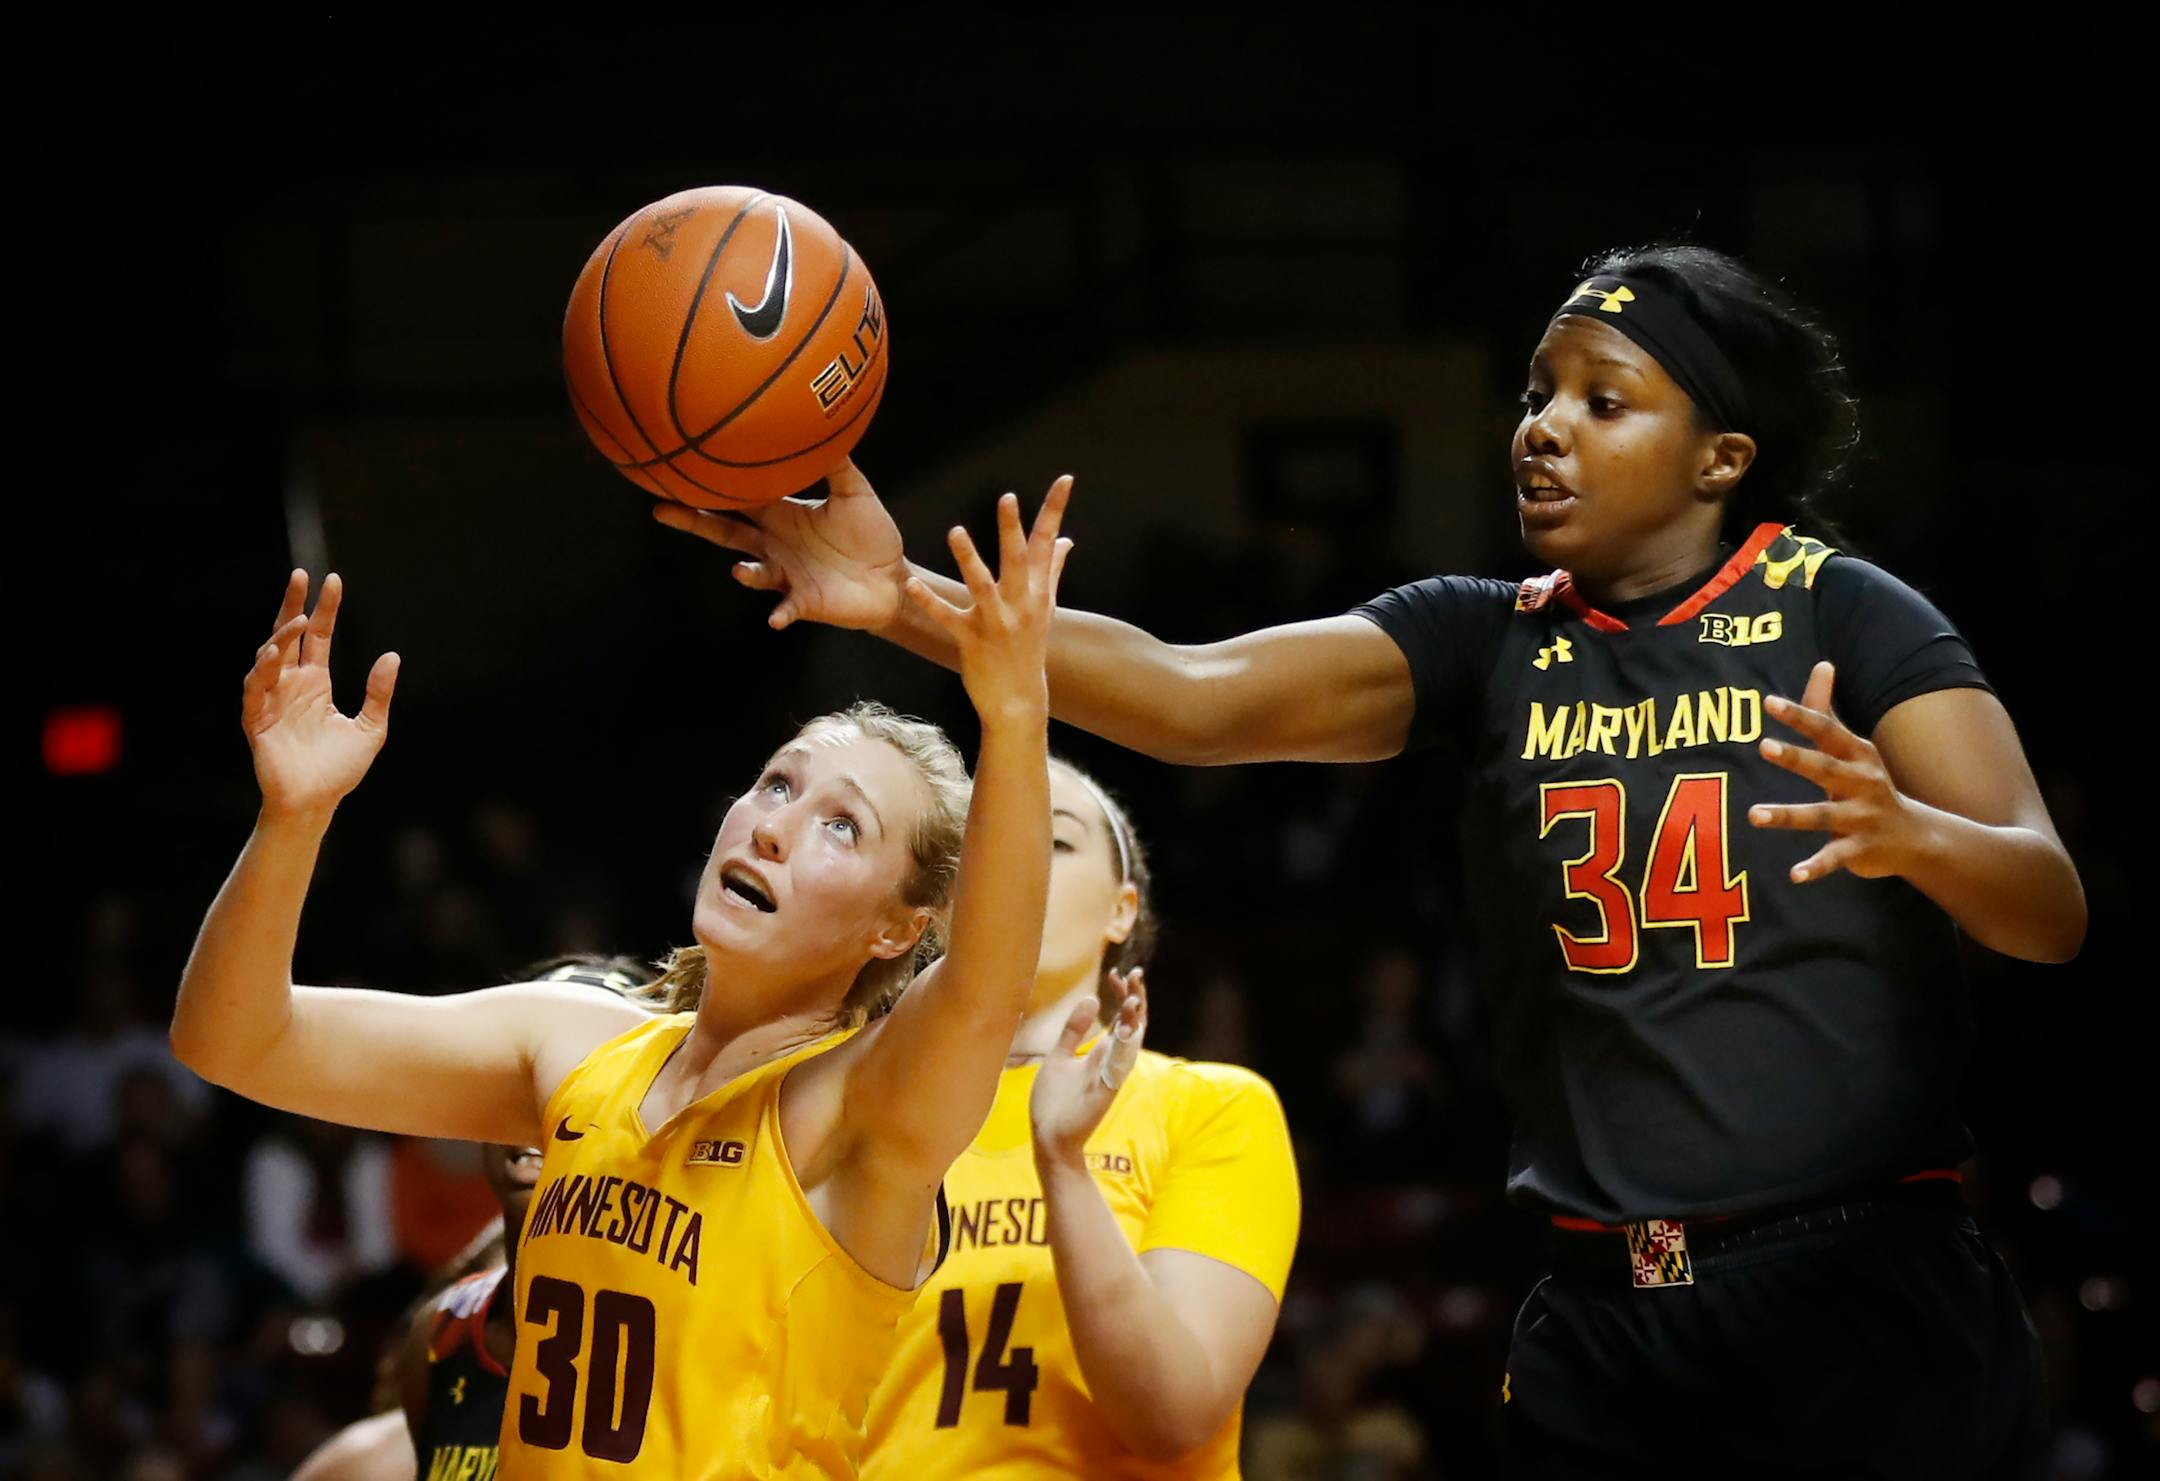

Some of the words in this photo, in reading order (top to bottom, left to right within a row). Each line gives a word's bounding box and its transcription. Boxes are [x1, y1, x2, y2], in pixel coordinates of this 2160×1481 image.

[810, 285, 881, 412] ELITE
[1521, 686, 1761, 760] MARYLAND
[1539, 771, 1750, 975] 34
[522, 1174, 704, 1287] MINNESOTA
[519, 1275, 656, 1464] 30
[935, 1282, 1038, 1429] 14
